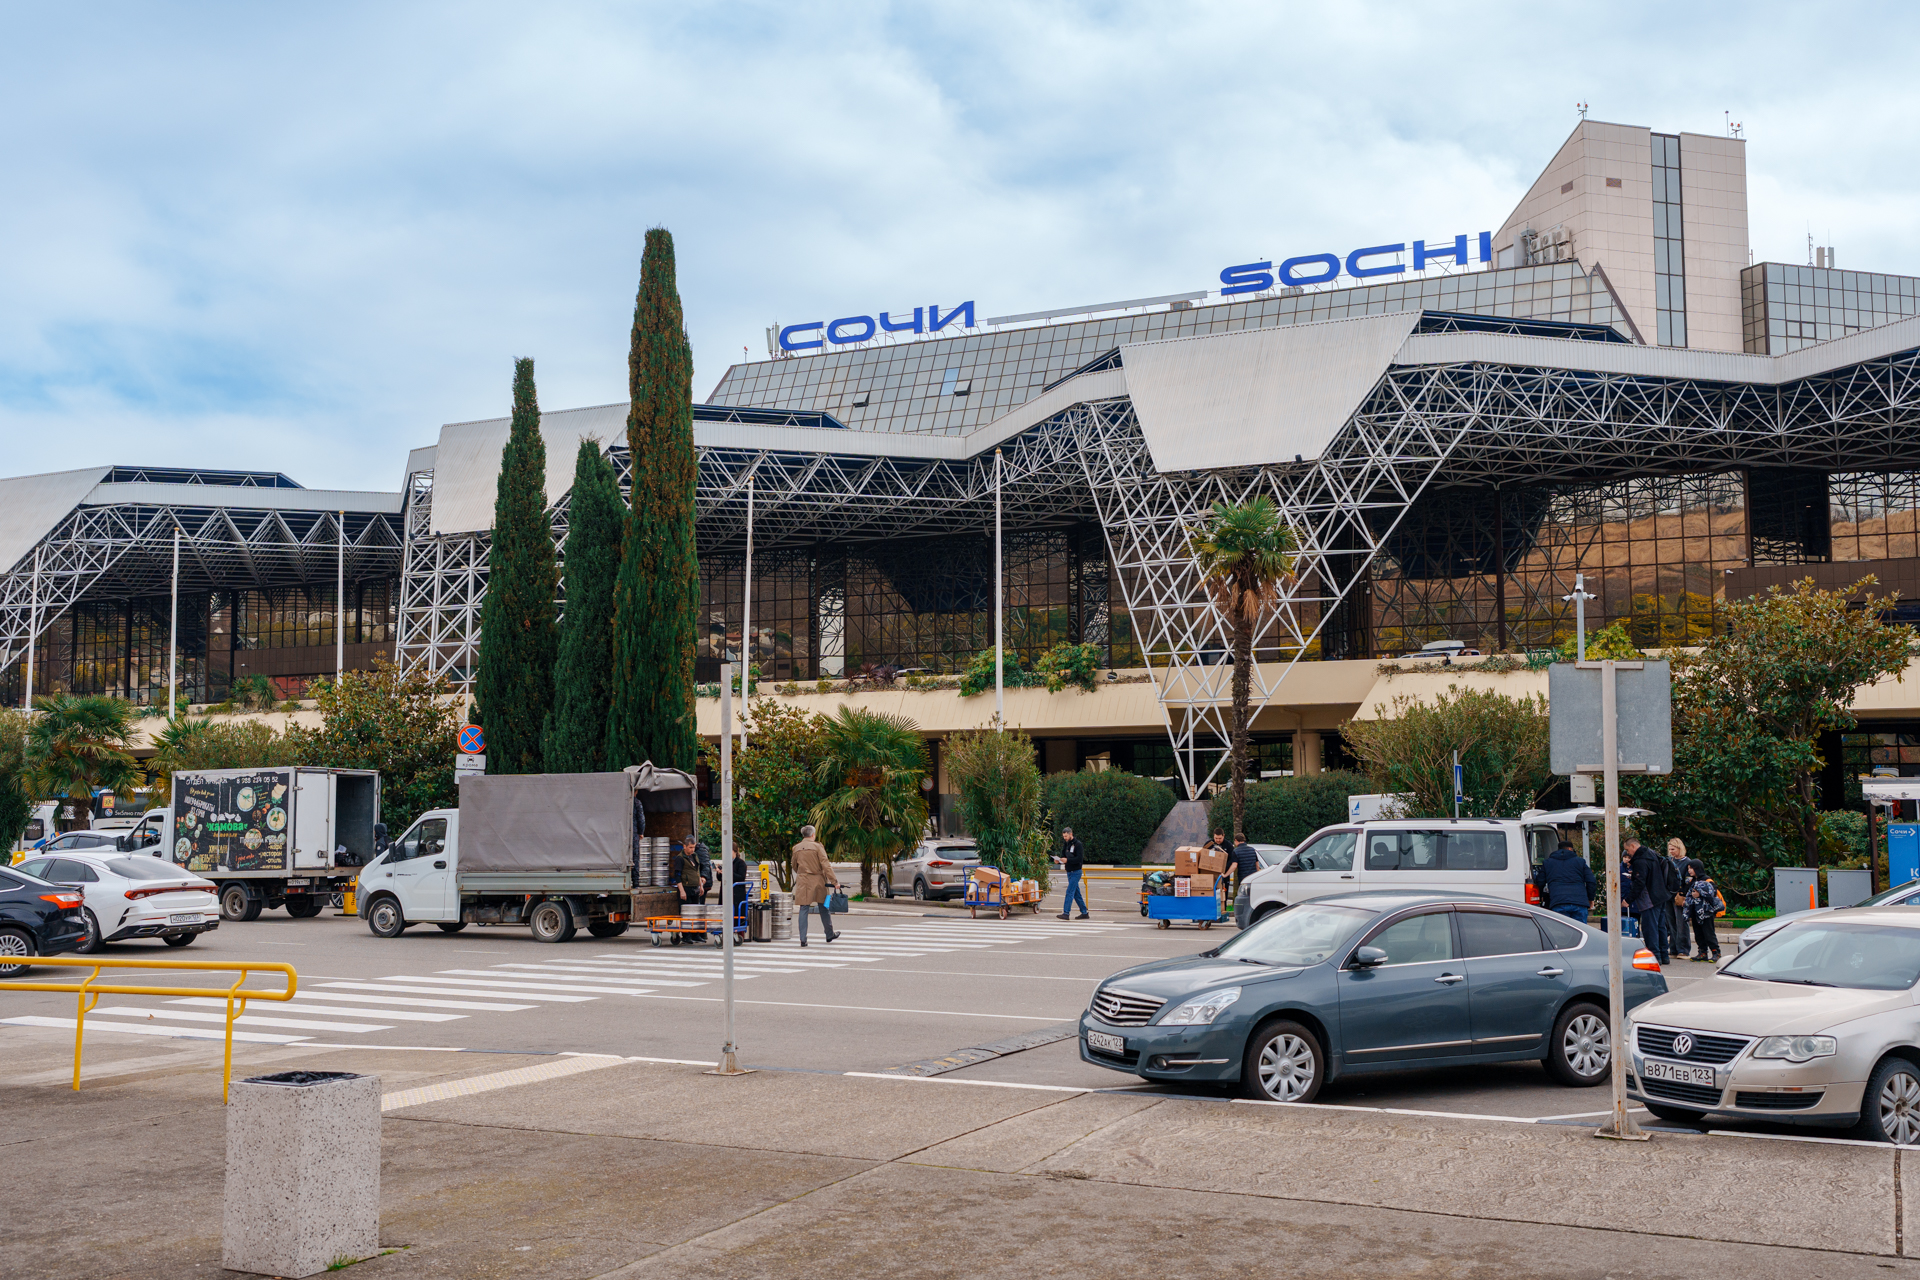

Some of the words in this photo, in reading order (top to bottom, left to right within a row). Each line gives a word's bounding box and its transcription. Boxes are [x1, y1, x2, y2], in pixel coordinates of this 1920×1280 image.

[1220, 231, 1491, 296] SOCHI
[779, 300, 975, 351] СОЧИ
[1648, 1064, 1690, 1081] В871ЕВ
[1692, 1068, 1710, 1080] 123
